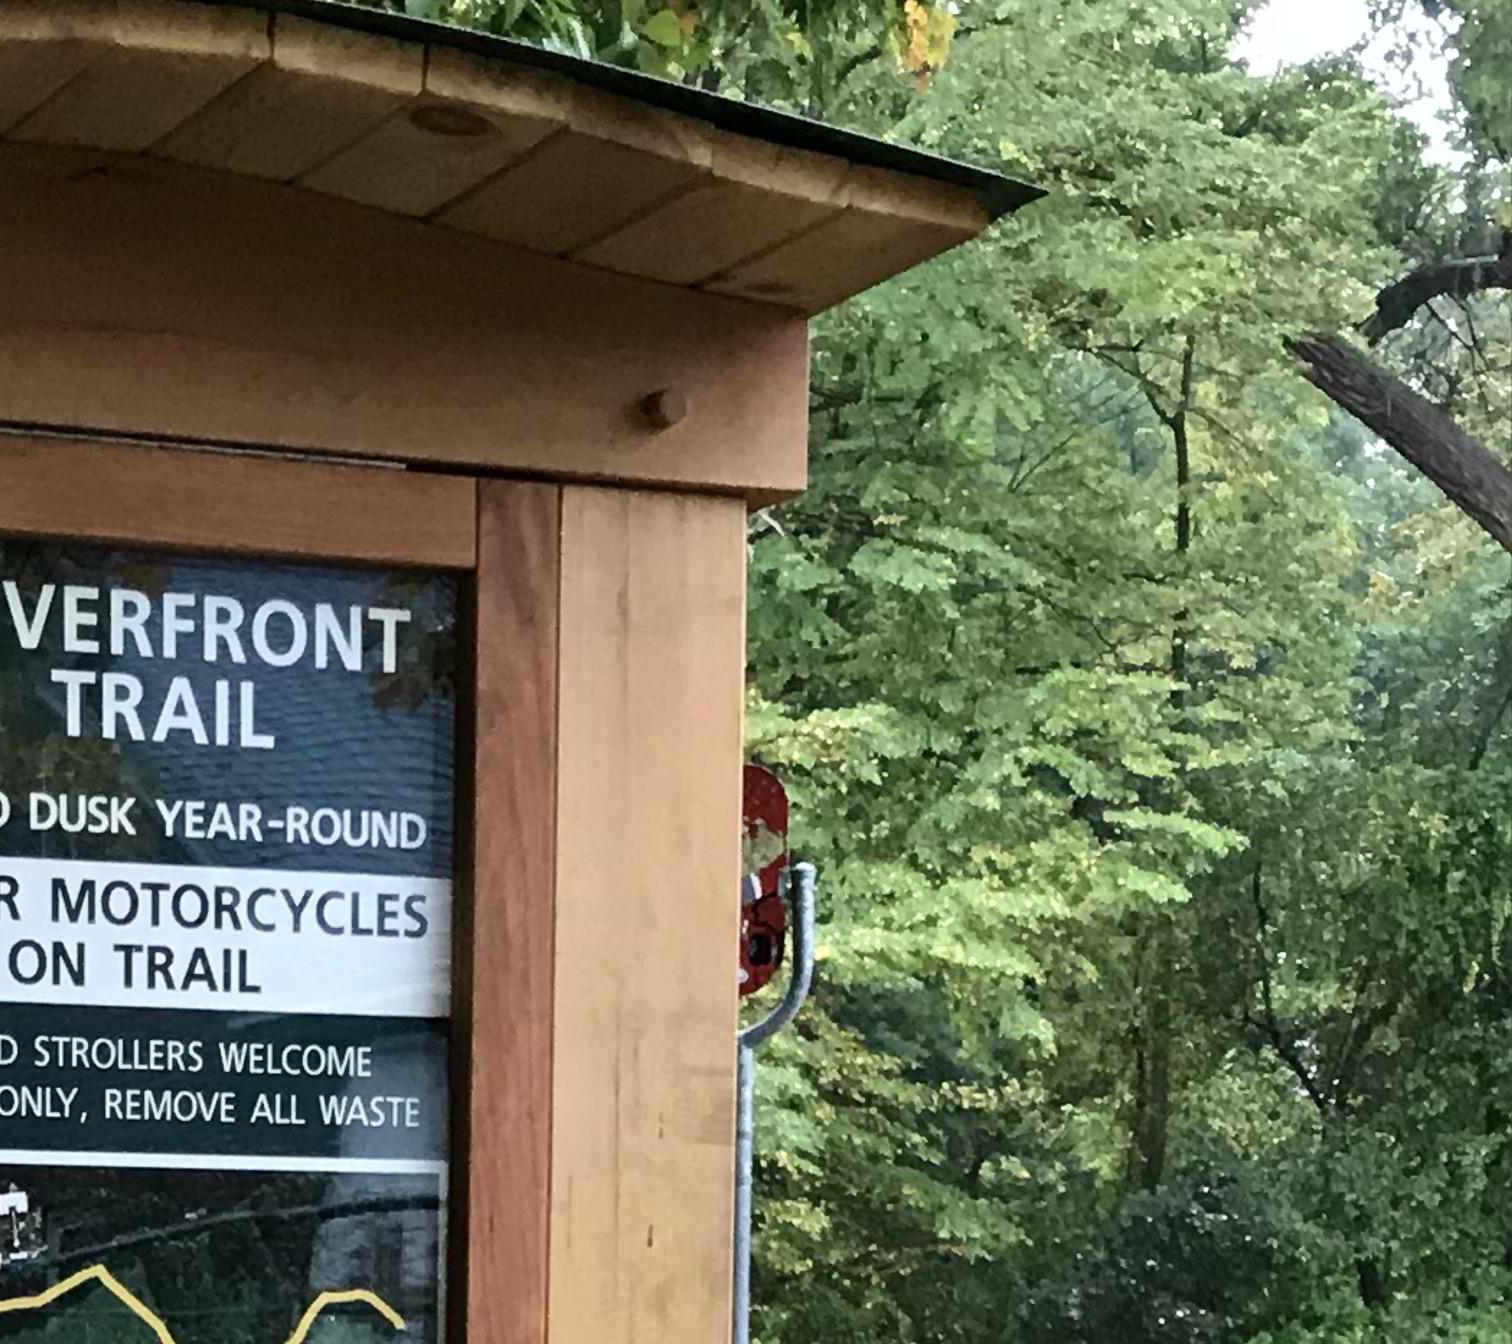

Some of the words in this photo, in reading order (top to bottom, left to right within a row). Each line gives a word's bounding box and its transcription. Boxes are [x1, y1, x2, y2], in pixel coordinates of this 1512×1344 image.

[51, 669, 276, 750] TRAIL
[30, 792, 136, 837] DUSK
[156, 799, 427, 850] YEAR-ROUND
[51, 878, 428, 939] MOTORCYCLES
[9, 939, 86, 986] ON
[114, 945, 261, 994] TRAIL
[33, 1036, 204, 1073] STROLLERS
[219, 1042, 373, 1077] WELCOME
[104, 1089, 236, 1124] REMOVE
[250, 1093, 305, 1125] ALL
[319, 1095, 421, 1128] WASTE
